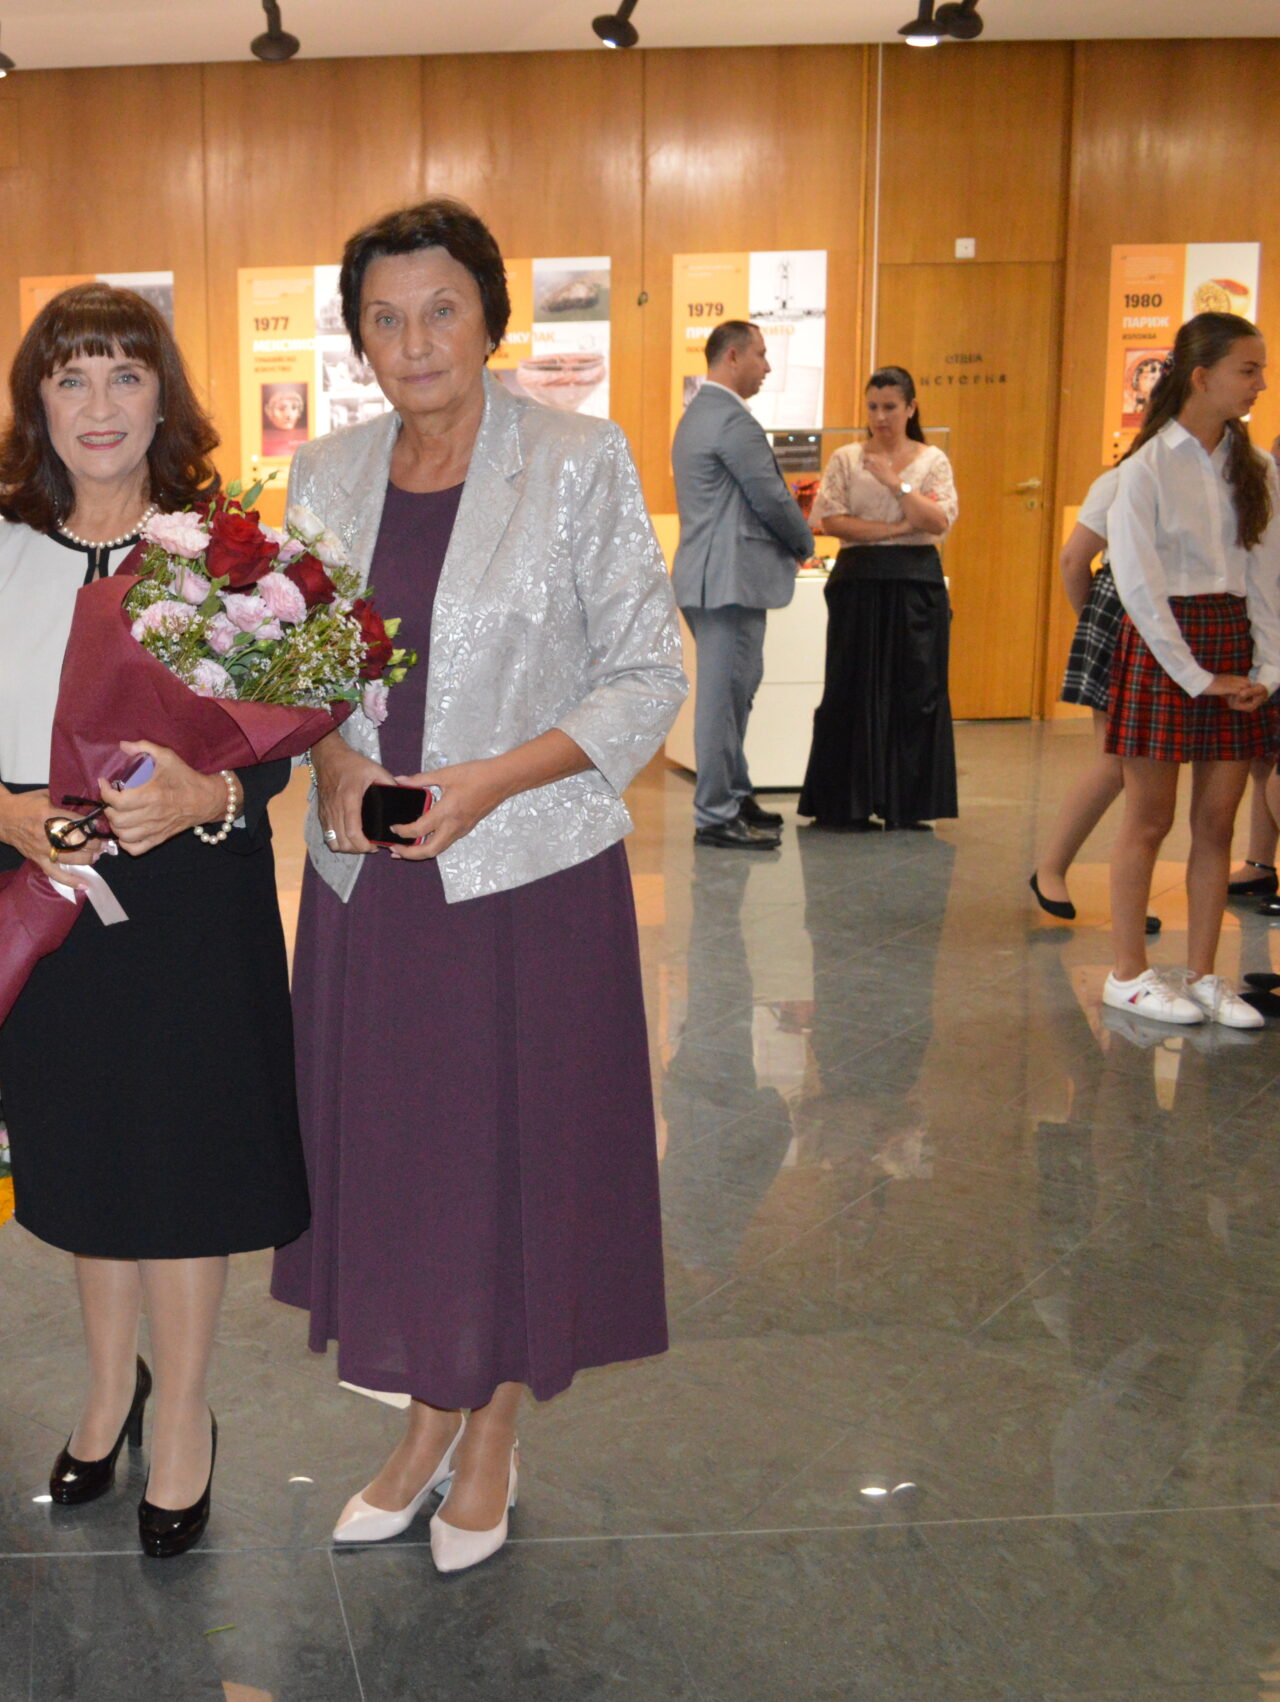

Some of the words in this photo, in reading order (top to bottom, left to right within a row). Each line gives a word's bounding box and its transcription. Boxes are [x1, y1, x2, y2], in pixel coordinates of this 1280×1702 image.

[1124, 293, 1163, 309] 1980
[687, 302, 725, 317] 1979
[253, 316, 289, 331] 1977
[1123, 315, 1170, 328] ПАРИЖ
